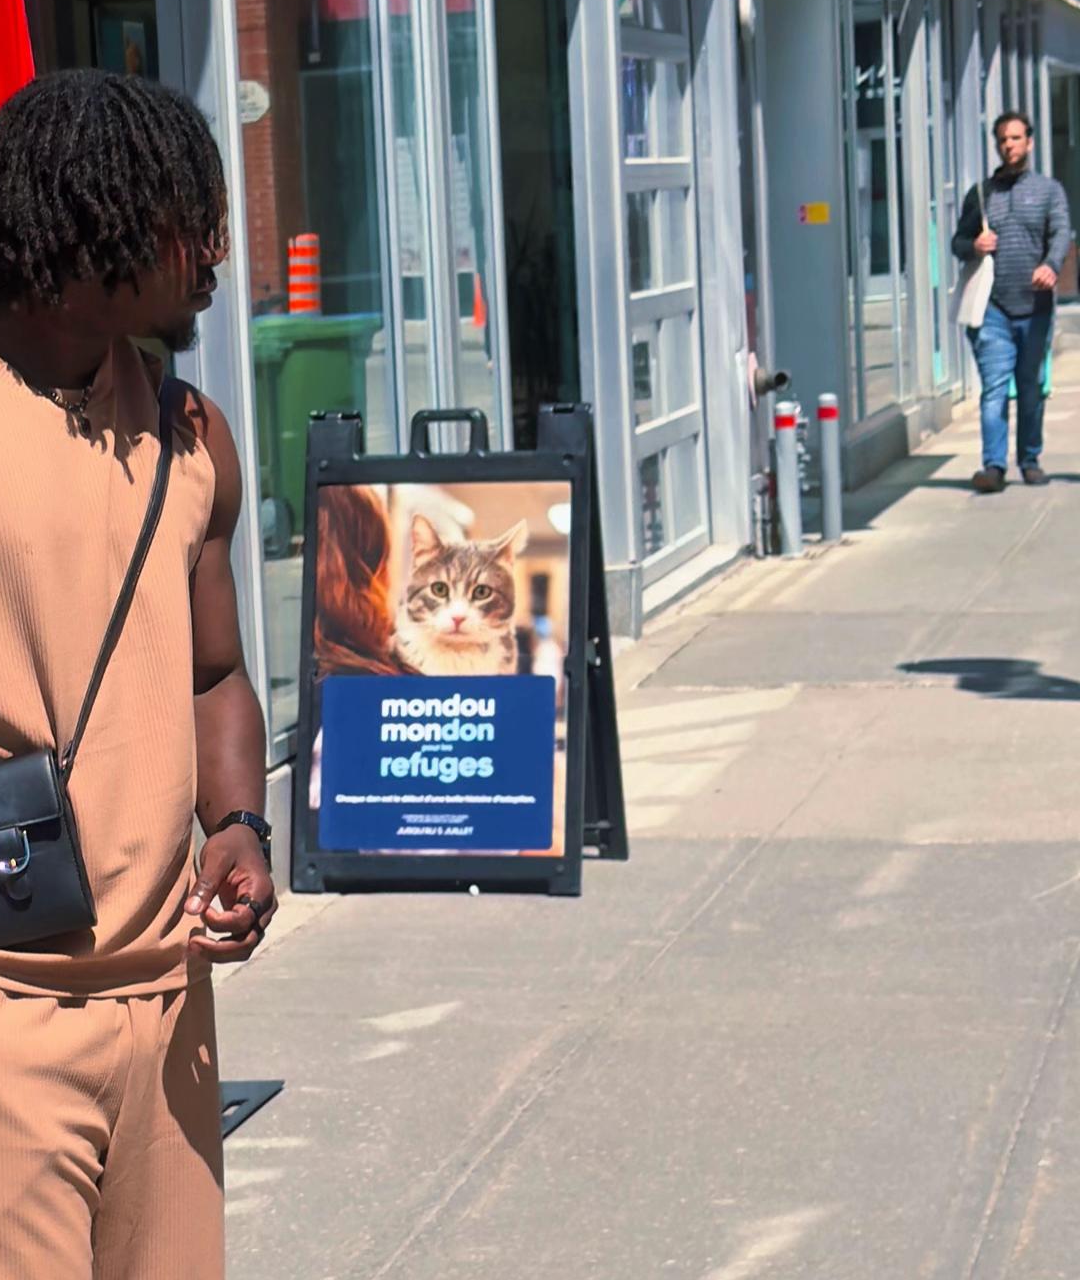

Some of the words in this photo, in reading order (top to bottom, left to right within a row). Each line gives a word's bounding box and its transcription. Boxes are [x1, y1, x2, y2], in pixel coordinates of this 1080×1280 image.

[381, 693, 496, 717] mondou
[380, 718, 495, 742] mondon
[380, 751, 495, 784] refuges
